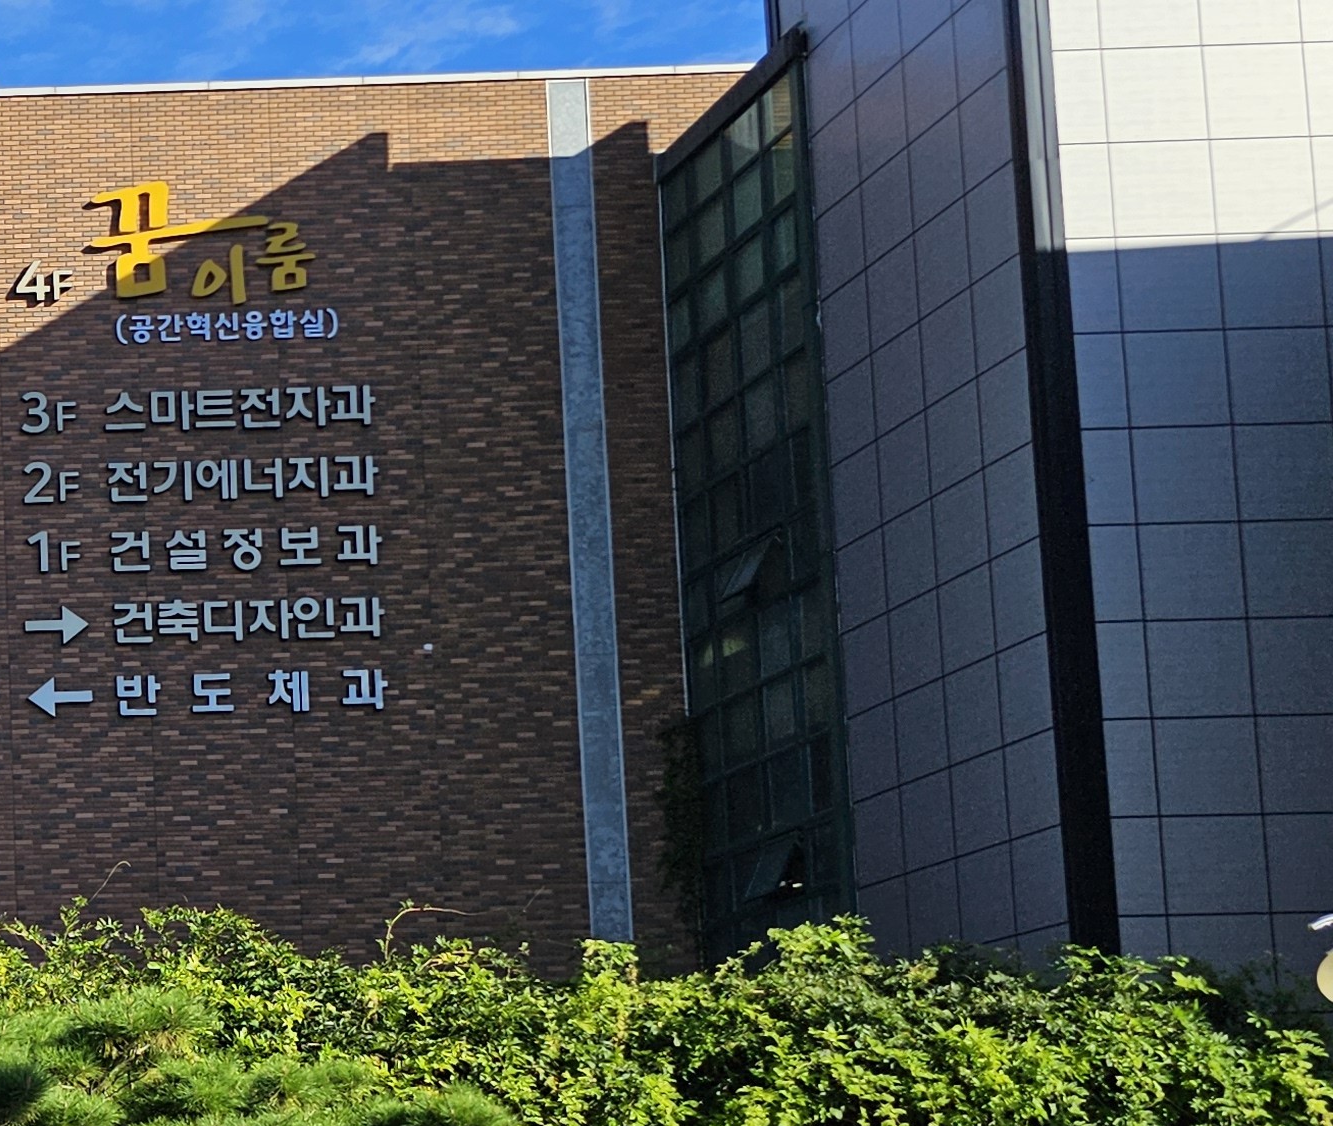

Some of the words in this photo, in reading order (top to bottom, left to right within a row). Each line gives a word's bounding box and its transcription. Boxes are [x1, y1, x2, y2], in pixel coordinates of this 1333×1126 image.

[16, 261, 73, 301] 4F
[115, 307, 339, 345] (공간혁신융합실)
[22, 391, 77, 434] 3F
[105, 384, 376, 432] 스마트전자과
[23, 461, 80, 504] 2F
[106, 455, 378, 502] 전기에너지과
[27, 530, 81, 573] 1F
[113, 596, 385, 644] 건축디자인과
